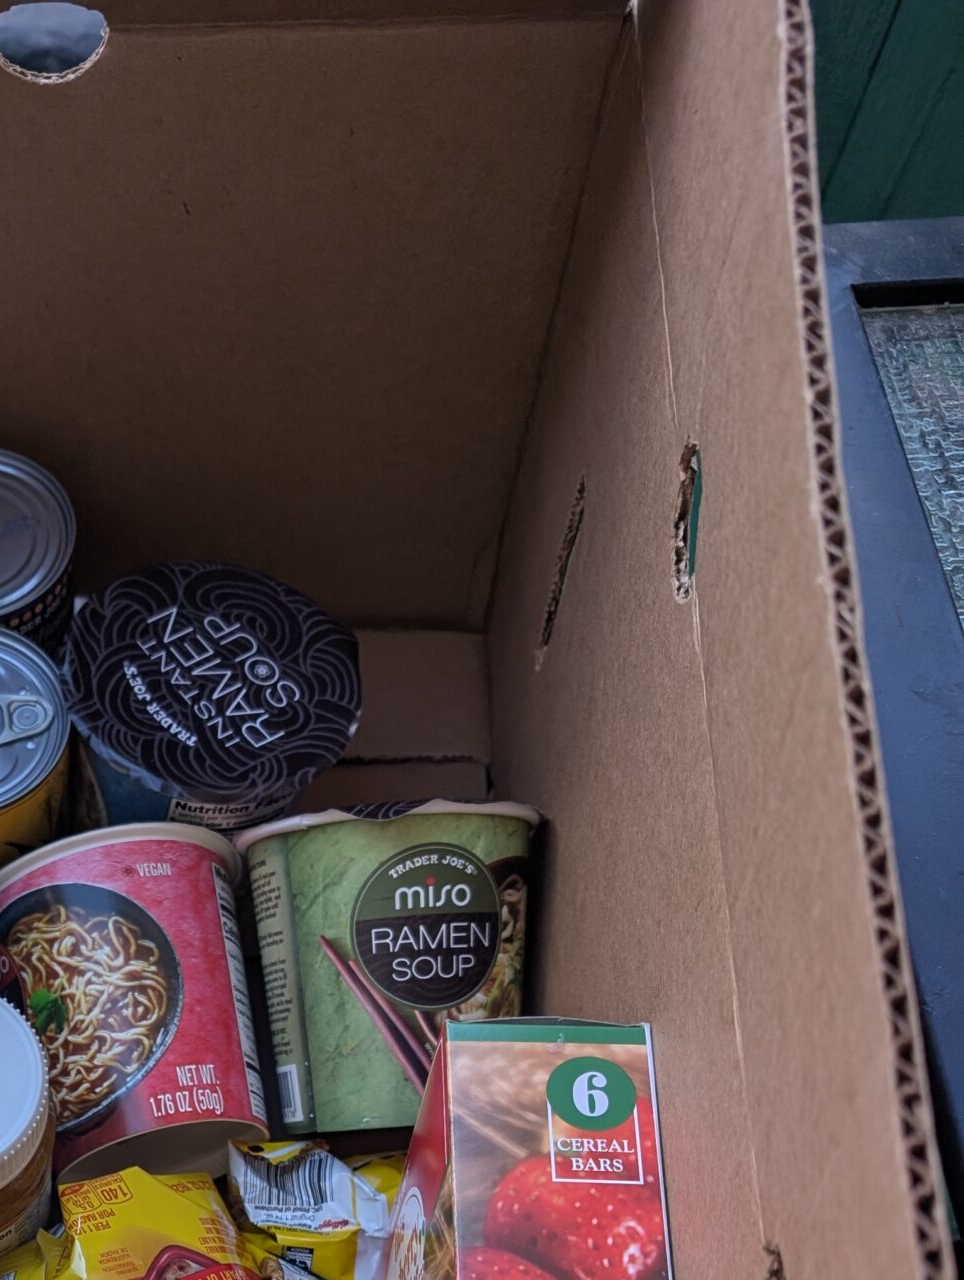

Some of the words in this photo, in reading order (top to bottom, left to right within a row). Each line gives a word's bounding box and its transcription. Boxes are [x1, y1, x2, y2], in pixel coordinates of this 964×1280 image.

[204, 615, 300, 708] SOUP
[124, 664, 151, 707] JOE'S
[147, 608, 285, 748] RAMEN
[137, 640, 240, 748] INSTANT
[147, 703, 198, 748] TRADER
[174, 800, 251, 815] Nutrition
[137, 863, 172, 877] VEGAN
[389, 854, 439, 879] TRADER
[442, 854, 476, 874] JOE'S
[394, 876, 471, 910] miso
[371, 921, 491, 954] RAMEN
[392, 954, 475, 982] SOUP
[176, 1066, 198, 1087] NET
[198, 1064, 221, 1085] WT.
[149, 1098, 174, 1118] 1.76
[176, 1095, 192, 1114] OZ
[193, 1090, 224, 1115] (50g)
[572, 1071, 609, 1117] 6
[556, 1137, 635, 1154] CEREAL
[570, 1156, 624, 1173] BARS
[100, 1184, 129, 1201] 140
[98, 1208, 116, 1219] POR
[254, 1205, 284, 1213] Purchase
[94, 1220, 112, 1232] PER
